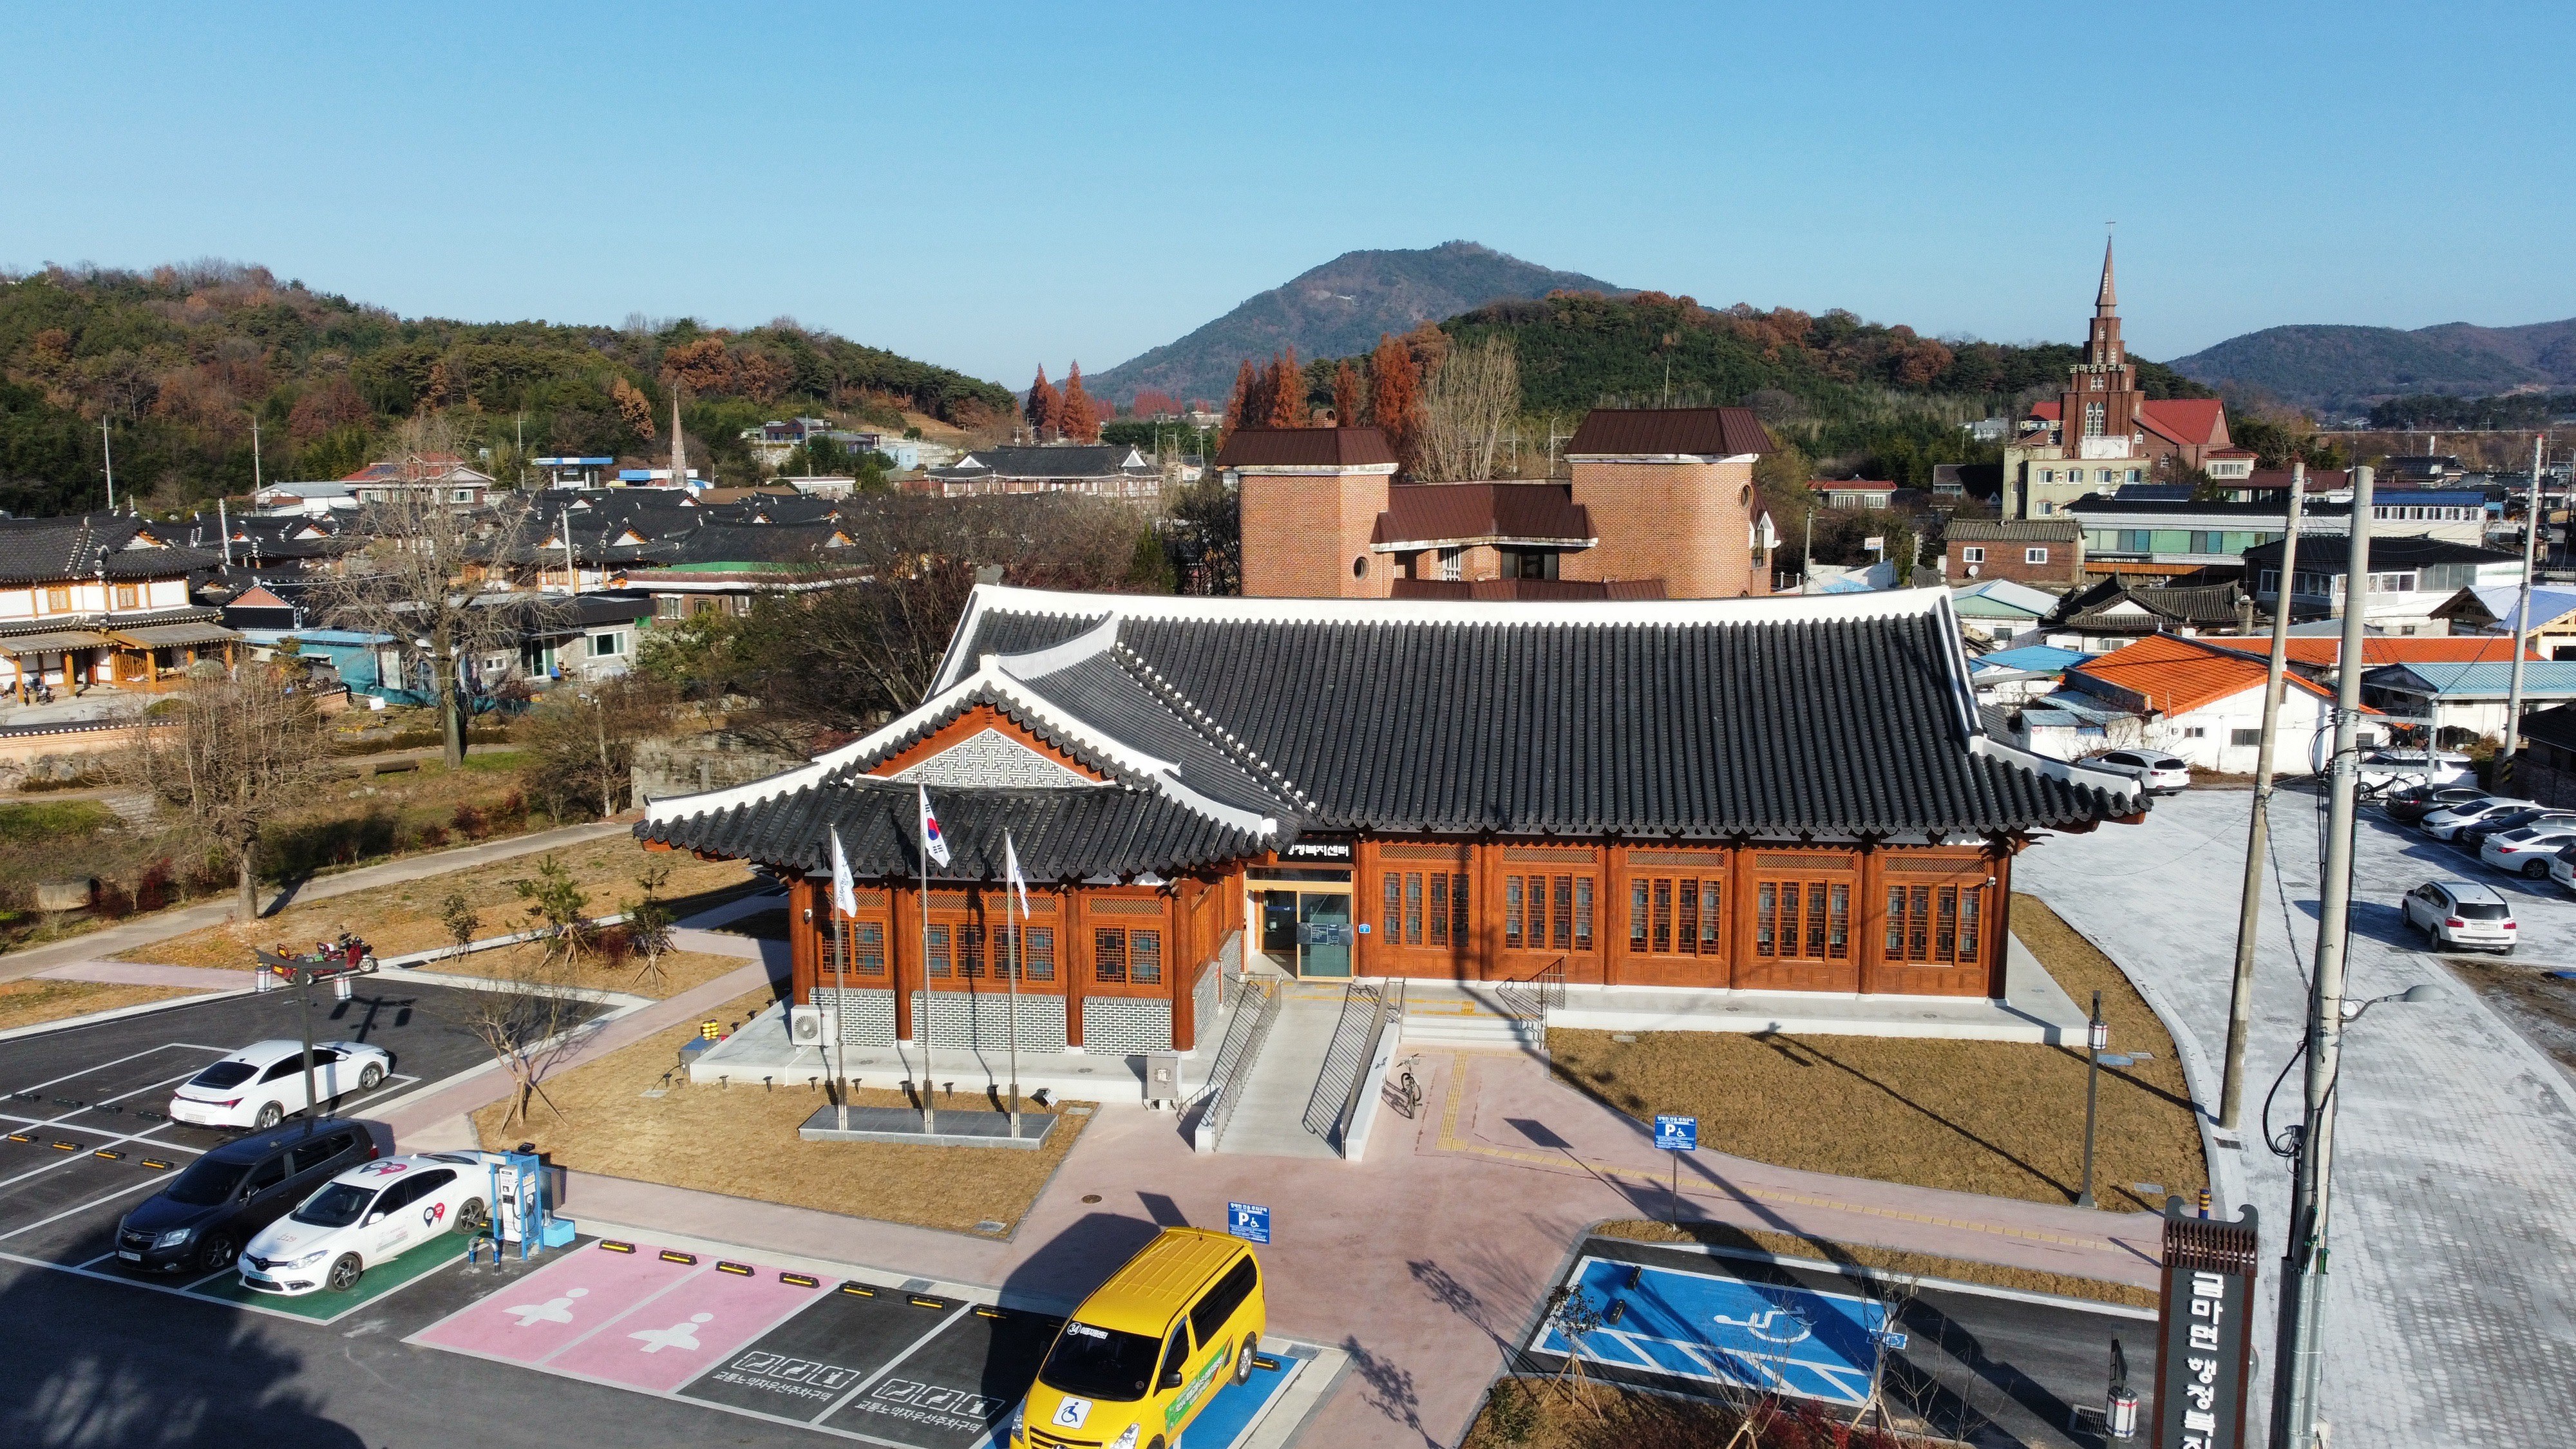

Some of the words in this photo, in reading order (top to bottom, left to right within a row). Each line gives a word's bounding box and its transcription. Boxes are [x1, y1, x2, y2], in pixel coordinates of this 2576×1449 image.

[1665, 1124, 1676, 1137] P
[1238, 1212, 1249, 1226] P
[2190, 1271, 2224, 1351] 금마면
